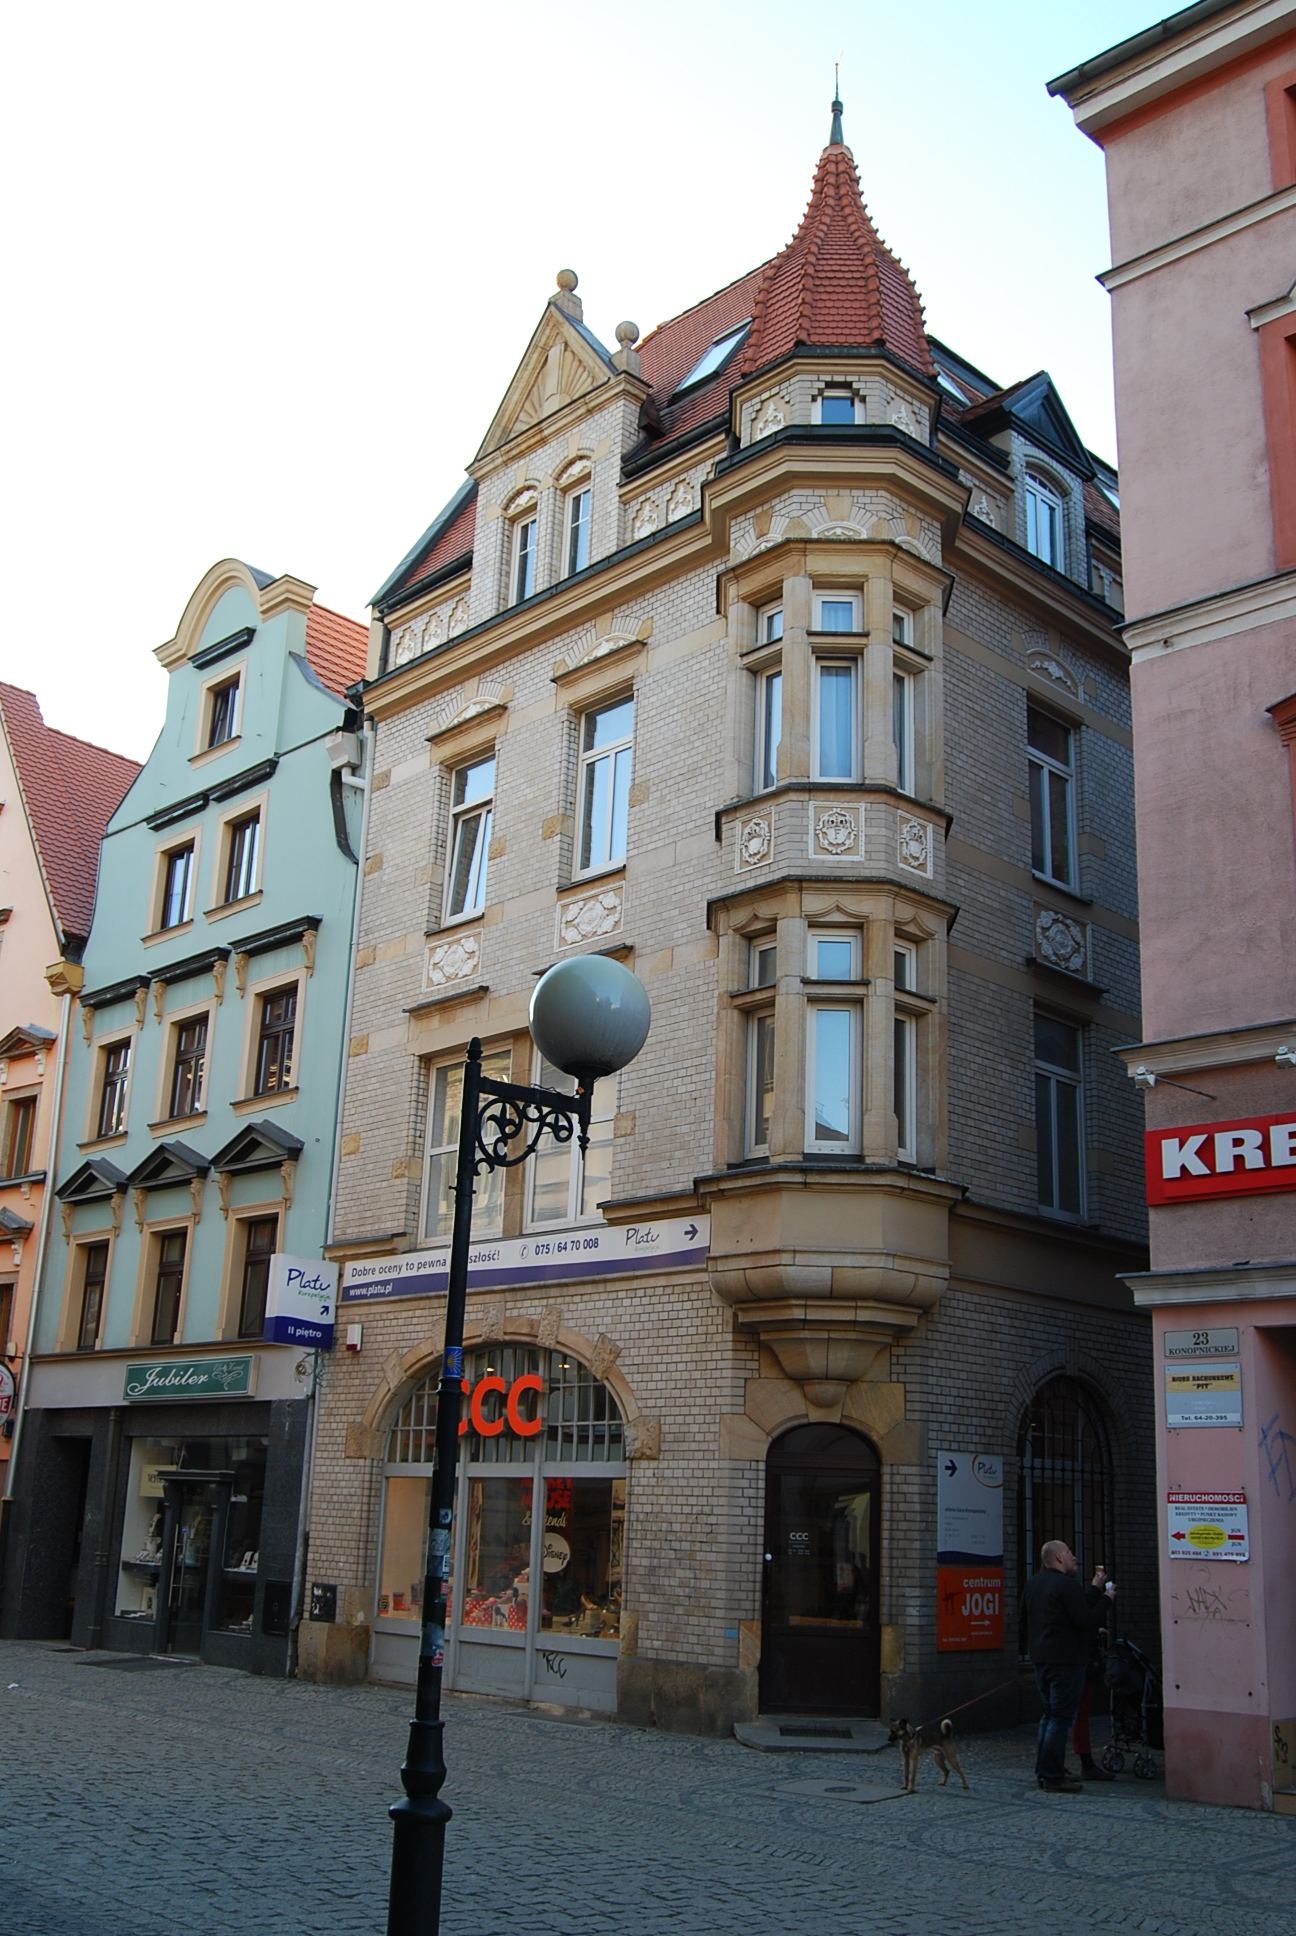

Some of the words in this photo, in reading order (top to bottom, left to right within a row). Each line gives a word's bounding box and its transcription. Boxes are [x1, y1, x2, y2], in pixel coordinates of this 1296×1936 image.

[626, 1227, 660, 1246] Platu
[351, 1266, 376, 1278] Dobre
[378, 1264, 403, 1276] oceny
[405, 1262, 415, 1271] to
[416, 1259, 447, 1273] pewna
[468, 1250, 500, 1264] szłość!
[534, 1241, 550, 1255] 075
[557, 1241, 568, 1253] 64
[570, 1239, 581, 1251] 70
[583, 1237, 599, 1250] 008
[286, 1268, 331, 1291] Platu
[350, 1283, 393, 1296] www.platu.pl
[287, 1326, 295, 1335] II
[295, 1327, 322, 1338] piętro
[1193, 1332, 1209, 1345] 23
[1168, 1345, 1235, 1356] KONOPNICKIEJ
[127, 1366, 209, 1396] Jubiler
[789, 1532, 809, 1541] CCC
[962, 1576, 1001, 1588] centrum
[961, 1592, 1000, 1617] JOGI
